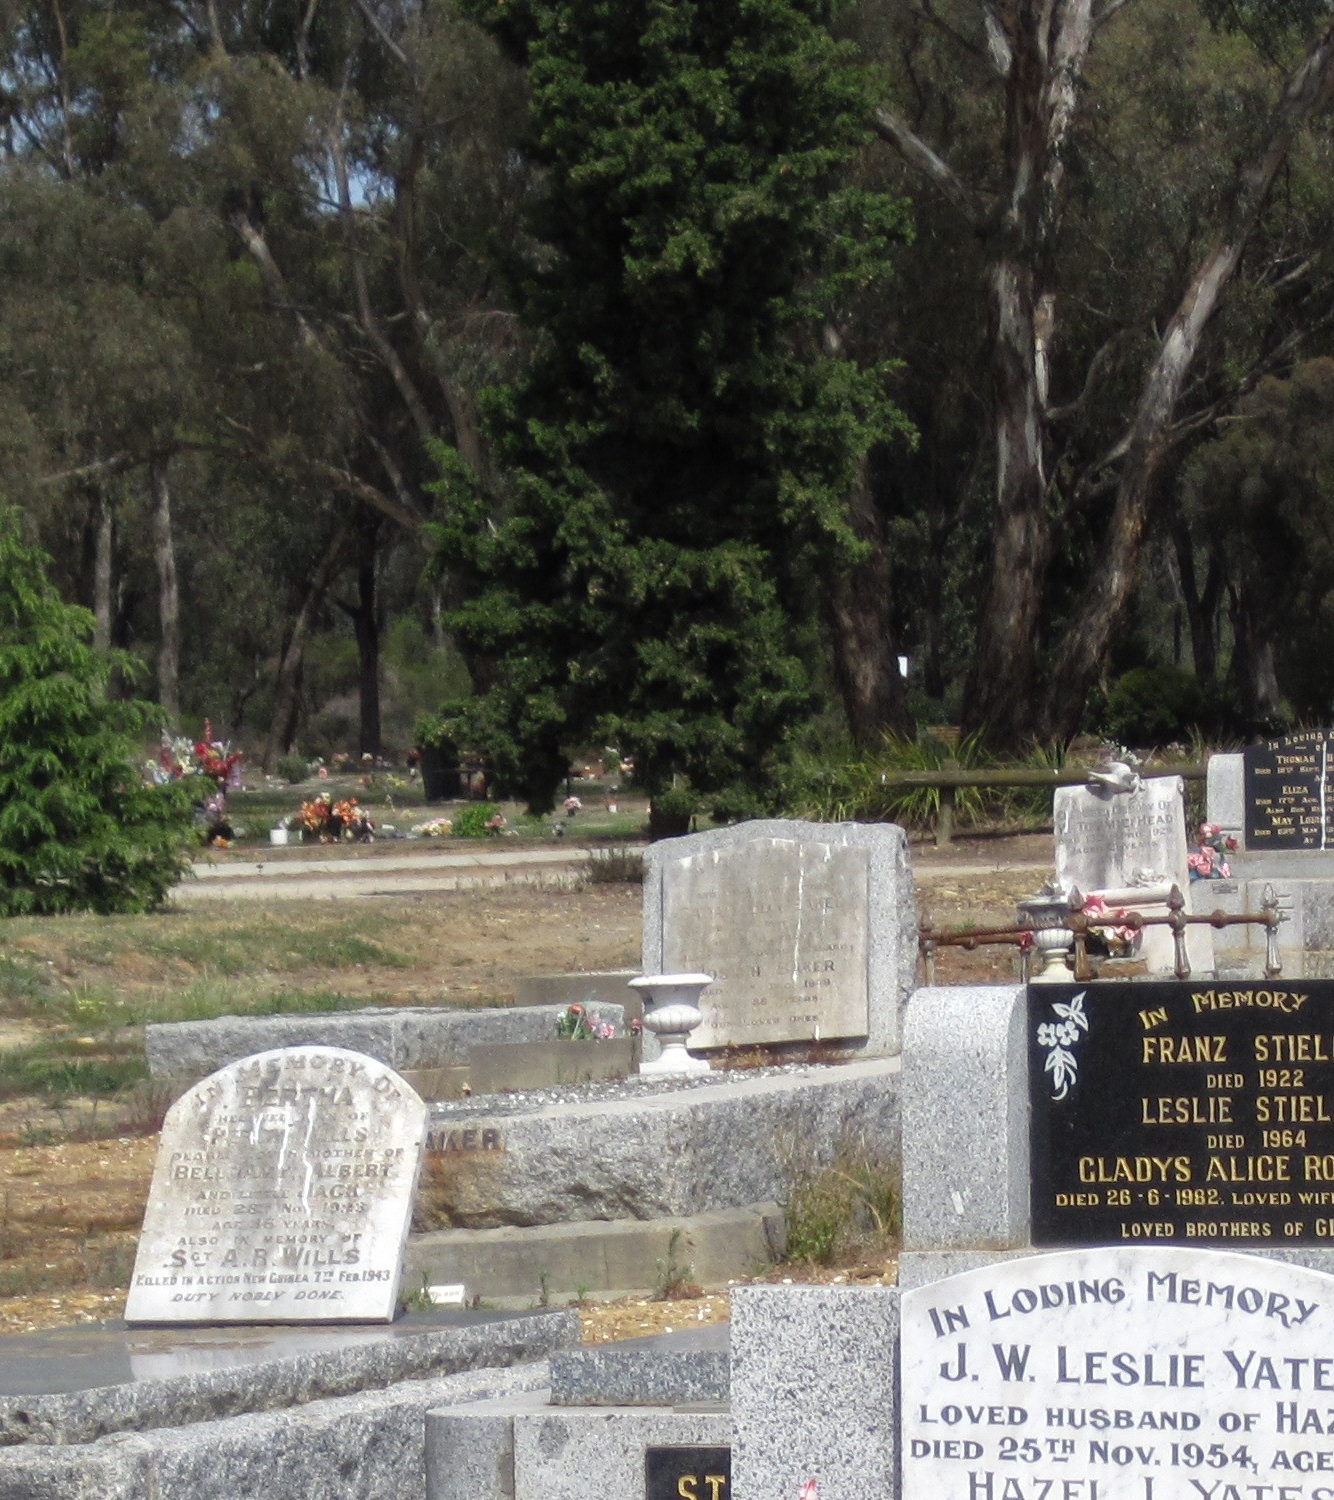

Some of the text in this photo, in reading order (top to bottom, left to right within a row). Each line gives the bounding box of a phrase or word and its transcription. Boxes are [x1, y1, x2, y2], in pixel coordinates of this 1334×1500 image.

[1139, 1007, 1168, 1030] IN
[1191, 990, 1308, 1013] MEMORY
[1141, 1036, 1228, 1064] FRANZ
[1206, 1069, 1305, 1089] DIED 1922
[1141, 1097, 1234, 1124] LESLIE
[1207, 1130, 1307, 1149] DIED 1964
[1079, 1156, 1192, 1183] GLADYS
[1206, 1155, 1290, 1182] ALICE
[1056, 1193, 1099, 1207] DIED
[1232, 1193, 1291, 1206] LOVED
[1121, 1222, 1174, 1239] LOVED
[1186, 1222, 1271, 1238] BROTHERS
[1284, 1221, 1304, 1237] OF
[283, 1249, 360, 1267] WILLS
[928, 1303, 969, 1338] IN
[983, 1277, 1126, 1322] LOVING
[1147, 1271, 1319, 1329] MEMORY
[940, 1343, 980, 1383] J.
[994, 1344, 1036, 1383] W.
[1057, 1345, 1205, 1388] LESLIE
[920, 1404, 1028, 1426] LOVED
[1046, 1407, 1201, 1432] HUSBAND
[1219, 1412, 1260, 1432] OF
[910, 1438, 984, 1461] DIED
[998, 1437, 1076, 1463] 25TH
[1088, 1441, 1161, 1467] NOV.
